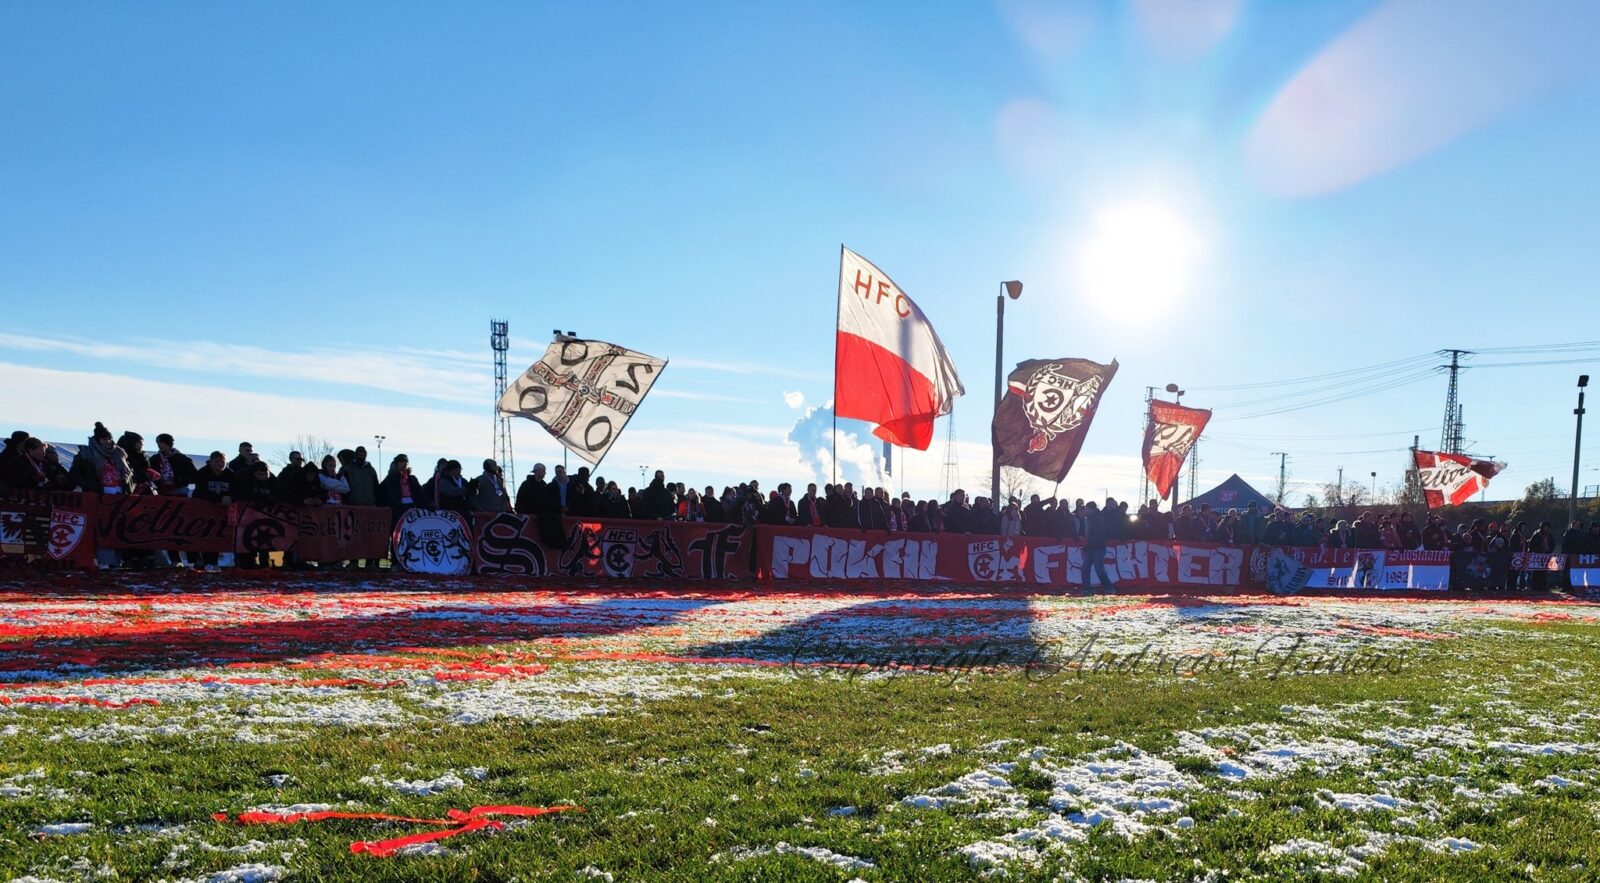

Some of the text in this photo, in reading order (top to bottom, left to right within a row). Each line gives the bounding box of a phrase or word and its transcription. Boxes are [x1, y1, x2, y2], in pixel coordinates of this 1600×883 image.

[854, 269, 911, 319] HFC
[53, 511, 79, 524] HFC
[98, 497, 229, 545] Köthen
[424, 531, 440, 539] HFC
[608, 530, 634, 541] HFC
[972, 541, 994, 553] HFC
[771, 534, 954, 580] POKAL
[1385, 571, 1409, 584] 1982
